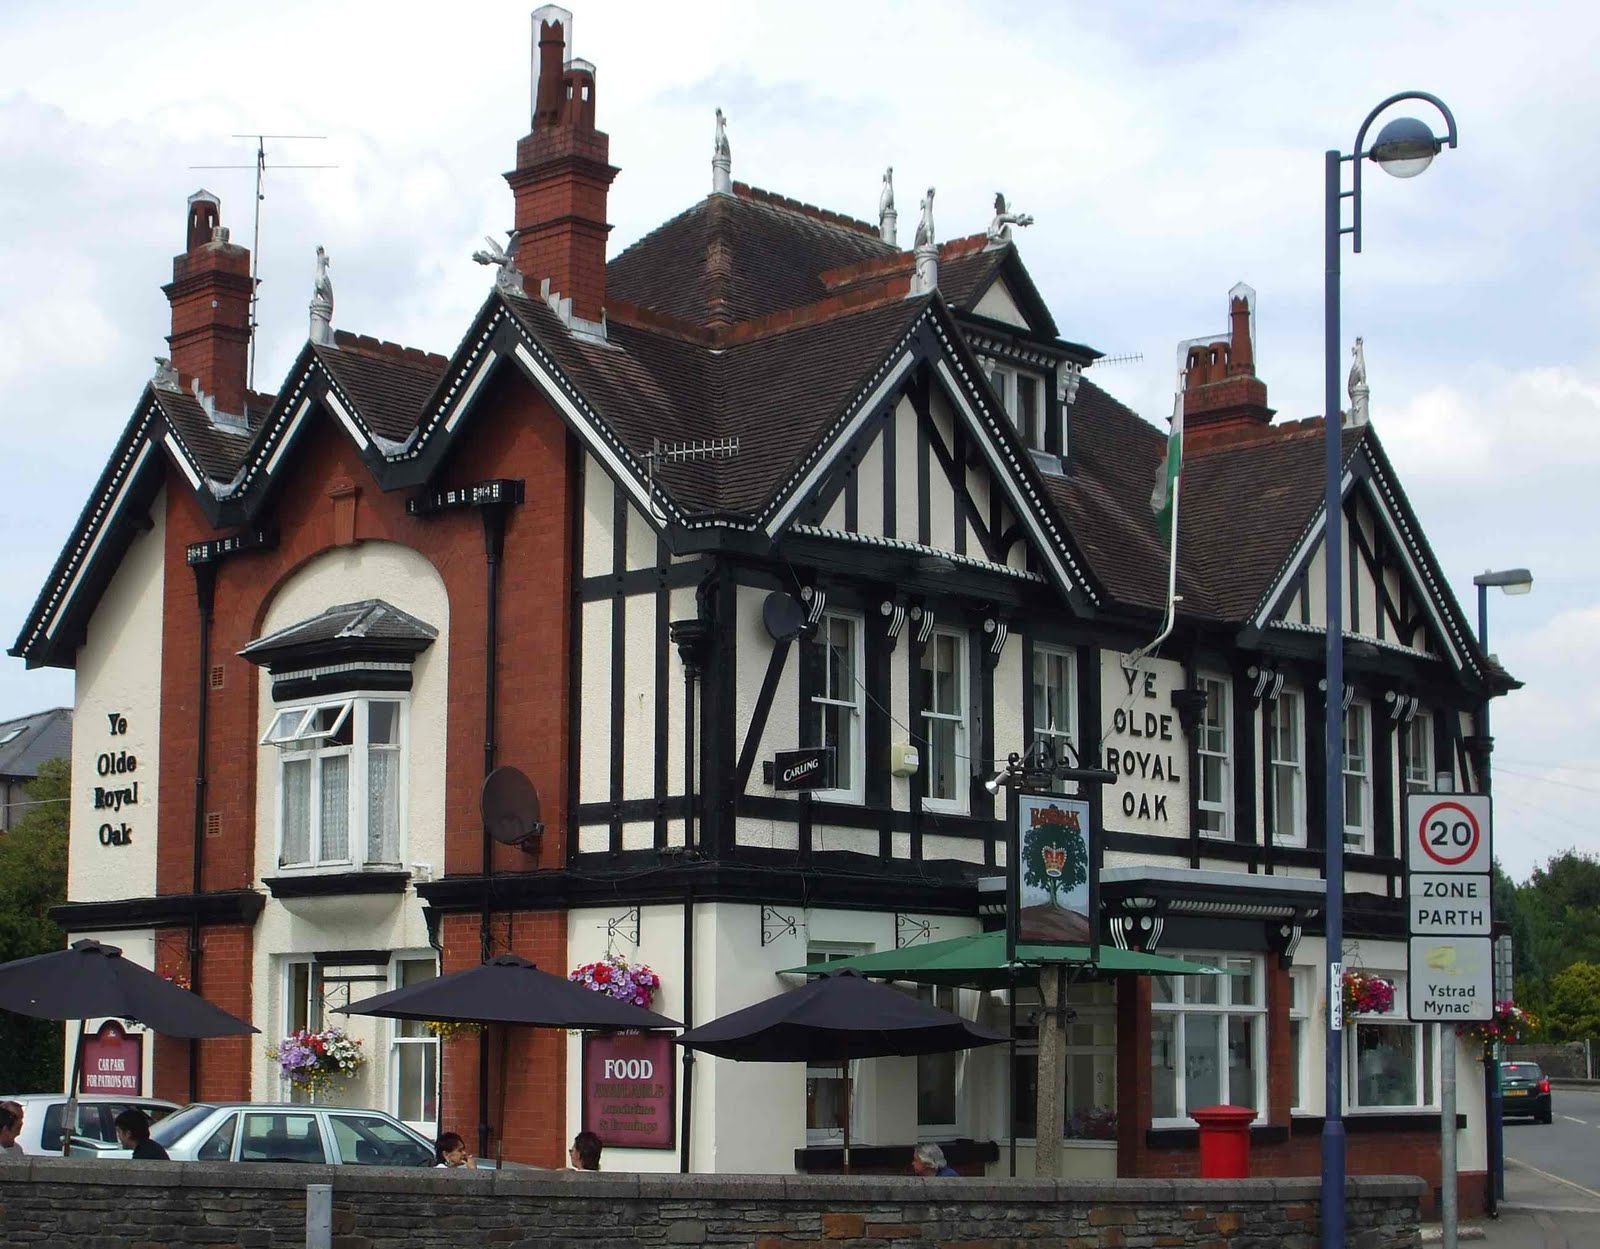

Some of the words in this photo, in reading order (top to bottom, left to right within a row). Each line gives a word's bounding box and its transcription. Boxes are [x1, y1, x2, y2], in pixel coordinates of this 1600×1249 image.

[1122, 666, 1157, 698] YE
[107, 713, 128, 736] Ye
[1113, 707, 1173, 740] OLDE
[97, 751, 137, 776] Olde
[1106, 747, 1180, 782] ROYAL
[94, 781, 138, 812] Royal
[1122, 791, 1168, 821] OAK
[98, 823, 133, 846] Oak
[1430, 820, 1472, 847] 20
[1423, 882, 1478, 898] ZONE
[1418, 909, 1483, 926] PARTH
[1428, 984, 1476, 998] Ystrad
[1424, 1000, 1474, 1015] Mynac
[98, 1058, 109, 1071] CAR
[110, 1058, 125, 1071] PARK
[604, 1058, 654, 1080] FOOD
[86, 1074, 97, 1087] FOR
[97, 1074, 121, 1088] PATRONS
[122, 1075, 136, 1088] ONLY
